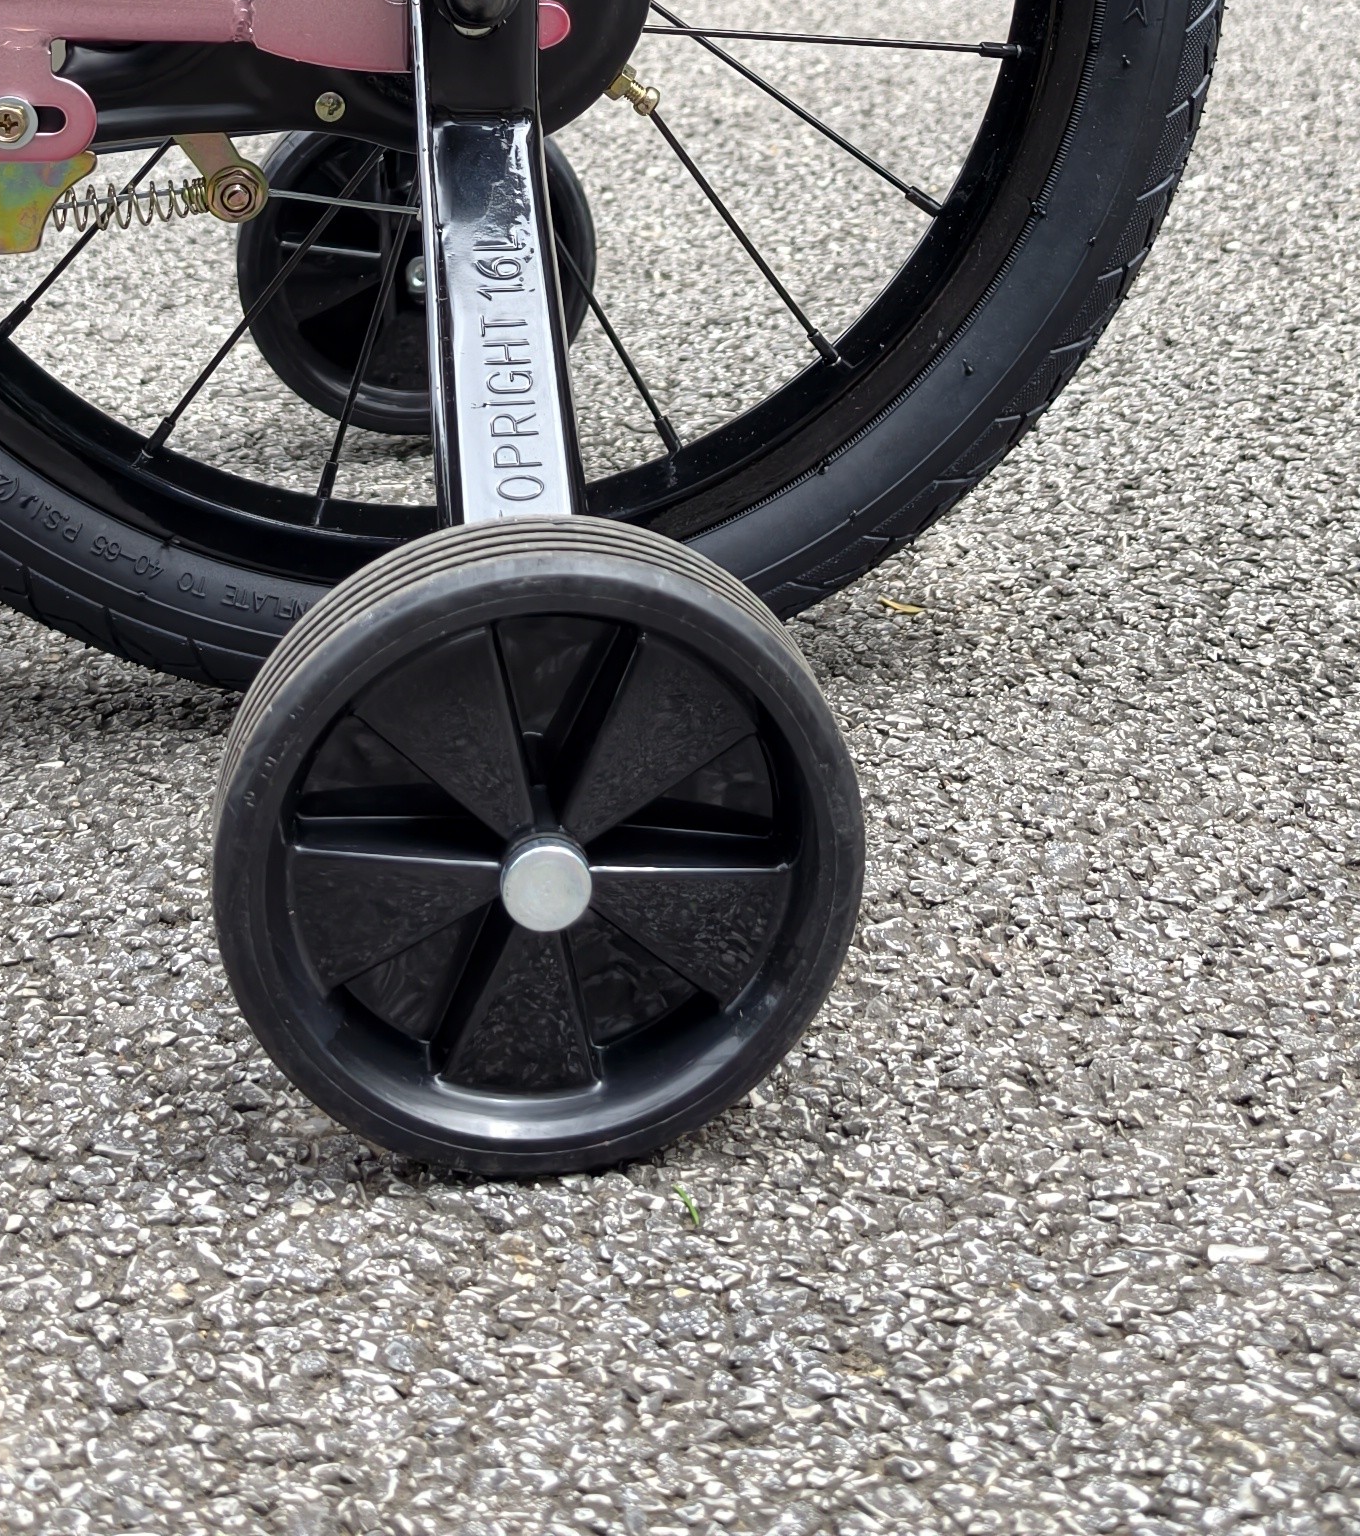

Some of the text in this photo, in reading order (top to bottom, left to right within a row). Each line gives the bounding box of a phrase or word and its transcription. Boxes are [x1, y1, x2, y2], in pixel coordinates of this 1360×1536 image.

[480, 314, 546, 519] OPRIGHT
[90, 535, 165, 580] 40-65
[177, 572, 207, 598] TO
[221, 584, 308, 620] NFLATE
